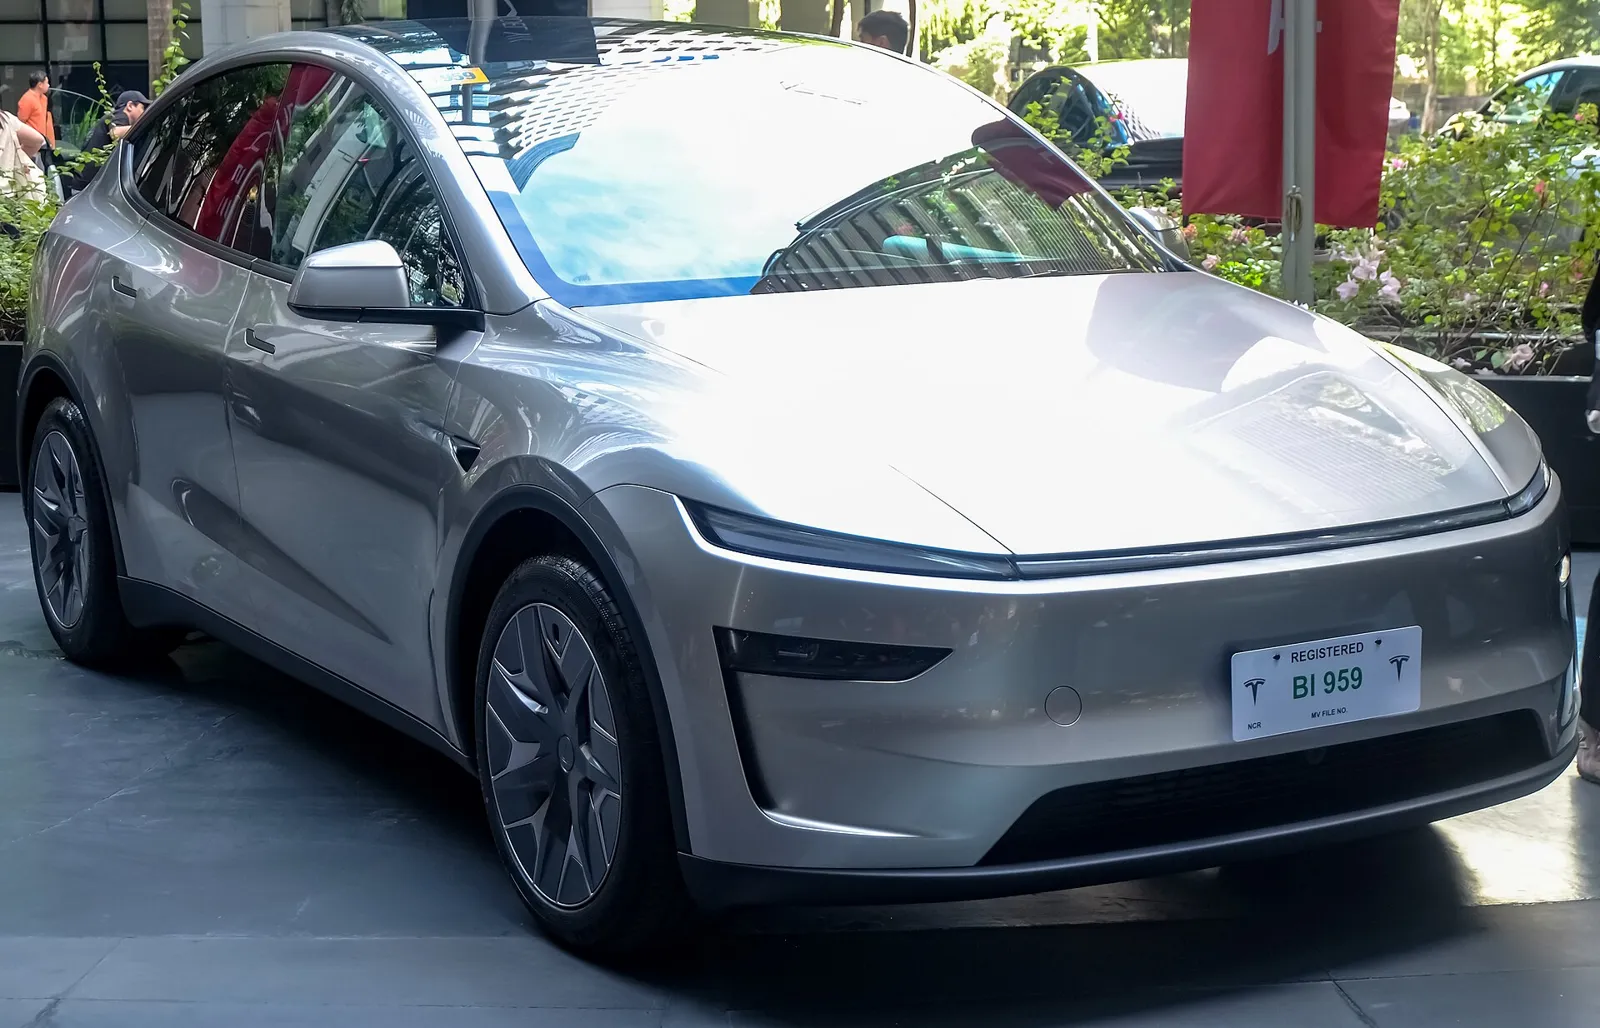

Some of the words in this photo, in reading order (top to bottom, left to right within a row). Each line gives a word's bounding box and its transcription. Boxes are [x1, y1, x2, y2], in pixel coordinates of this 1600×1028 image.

[1291, 642, 1364, 663] REGISTERED
[1293, 673, 1315, 699] BI
[1323, 666, 1363, 694] 959
[1336, 707, 1348, 715] NO.
[1247, 721, 1262, 730] NCR
